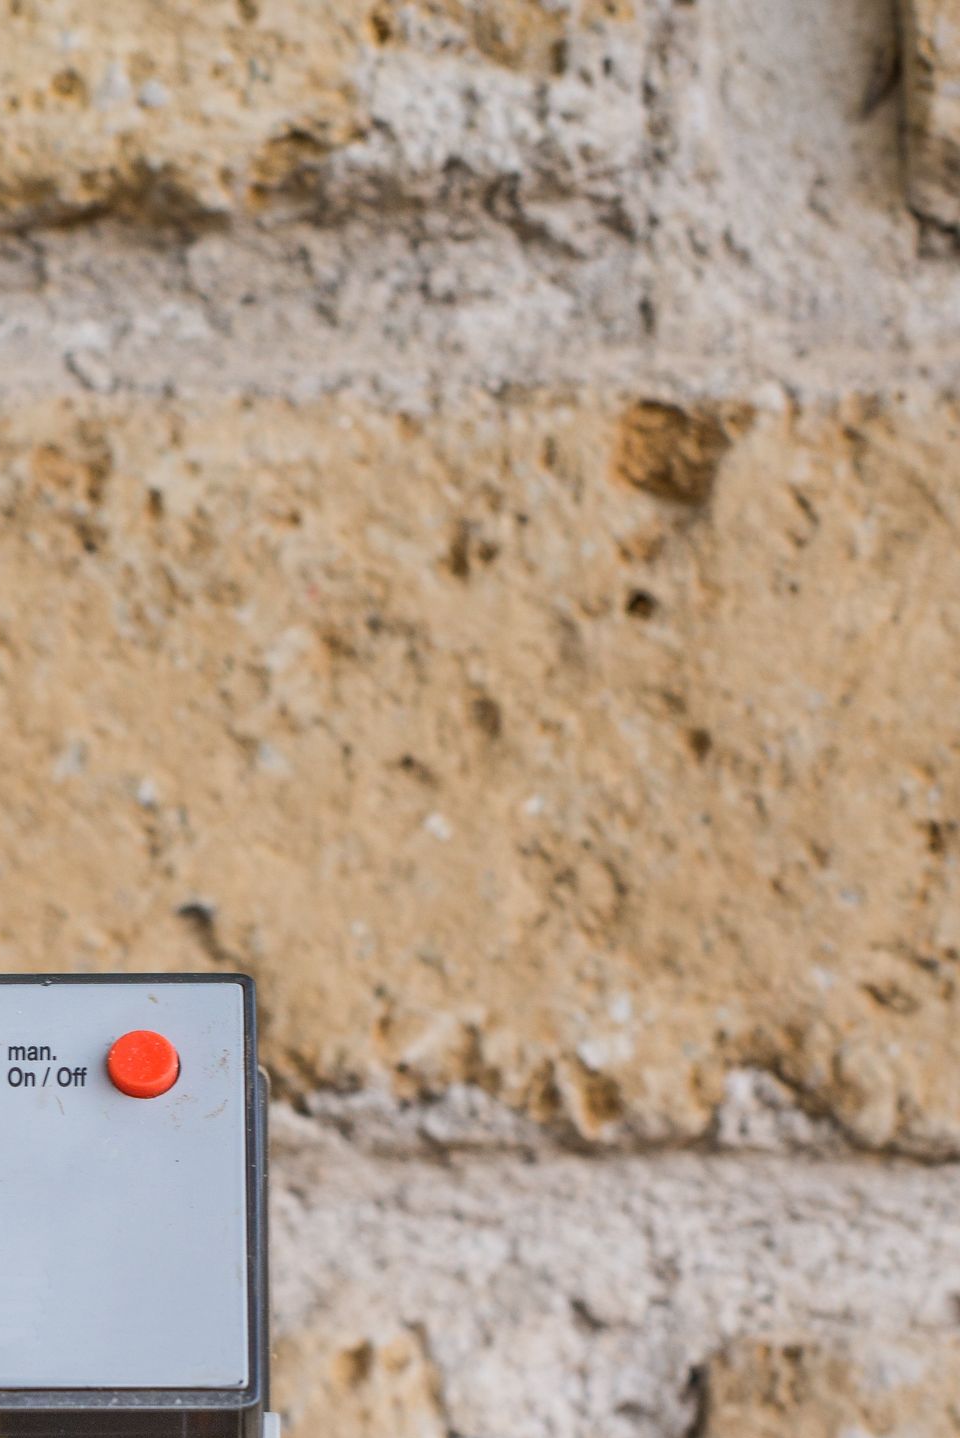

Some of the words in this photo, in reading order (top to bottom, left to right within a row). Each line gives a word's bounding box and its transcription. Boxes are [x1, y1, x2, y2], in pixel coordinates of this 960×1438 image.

[7, 1044, 57, 1062] man.
[7, 1067, 37, 1088] On
[56, 1067, 88, 1088] Off
